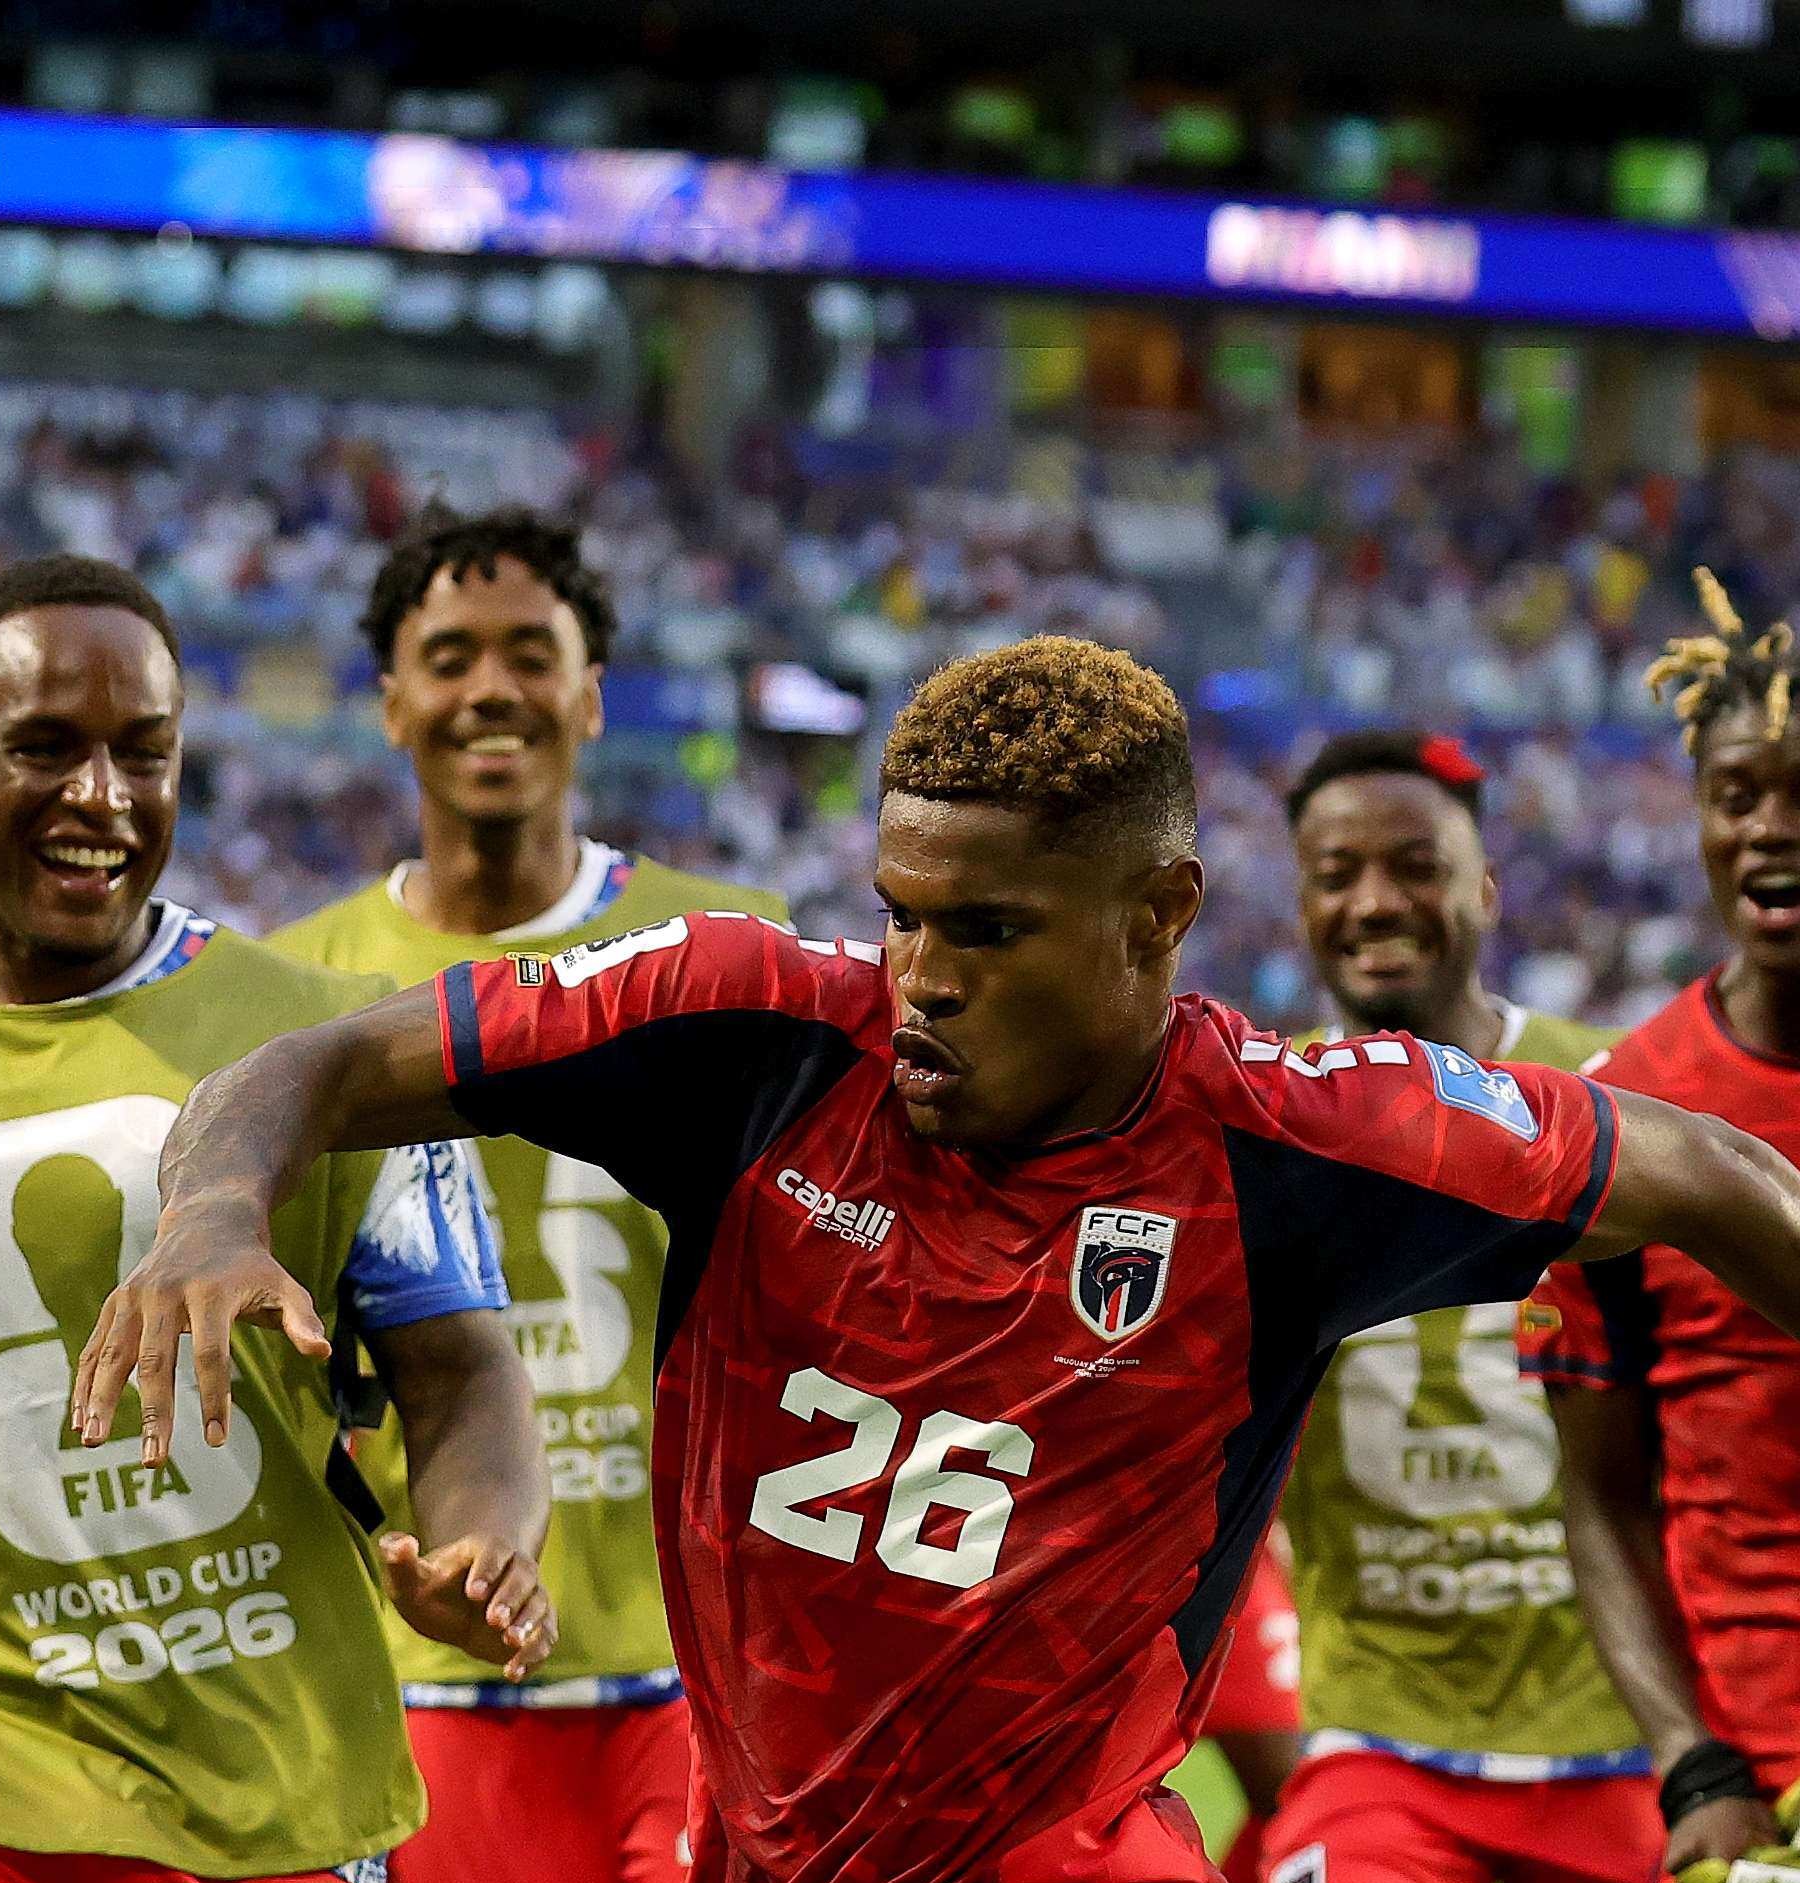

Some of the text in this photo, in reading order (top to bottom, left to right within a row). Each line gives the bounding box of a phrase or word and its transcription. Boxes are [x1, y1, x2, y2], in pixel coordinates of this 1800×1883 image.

[777, 1168, 896, 1243] capelli
[813, 1216, 881, 1252] SPORT
[1089, 1212, 1169, 1237] FCF
[61, 1457, 192, 1518] FIFA
[750, 1366, 1036, 1589] 26
[12, 1541, 282, 1629] WORLD CUP
[30, 1591, 296, 1690] 2026
